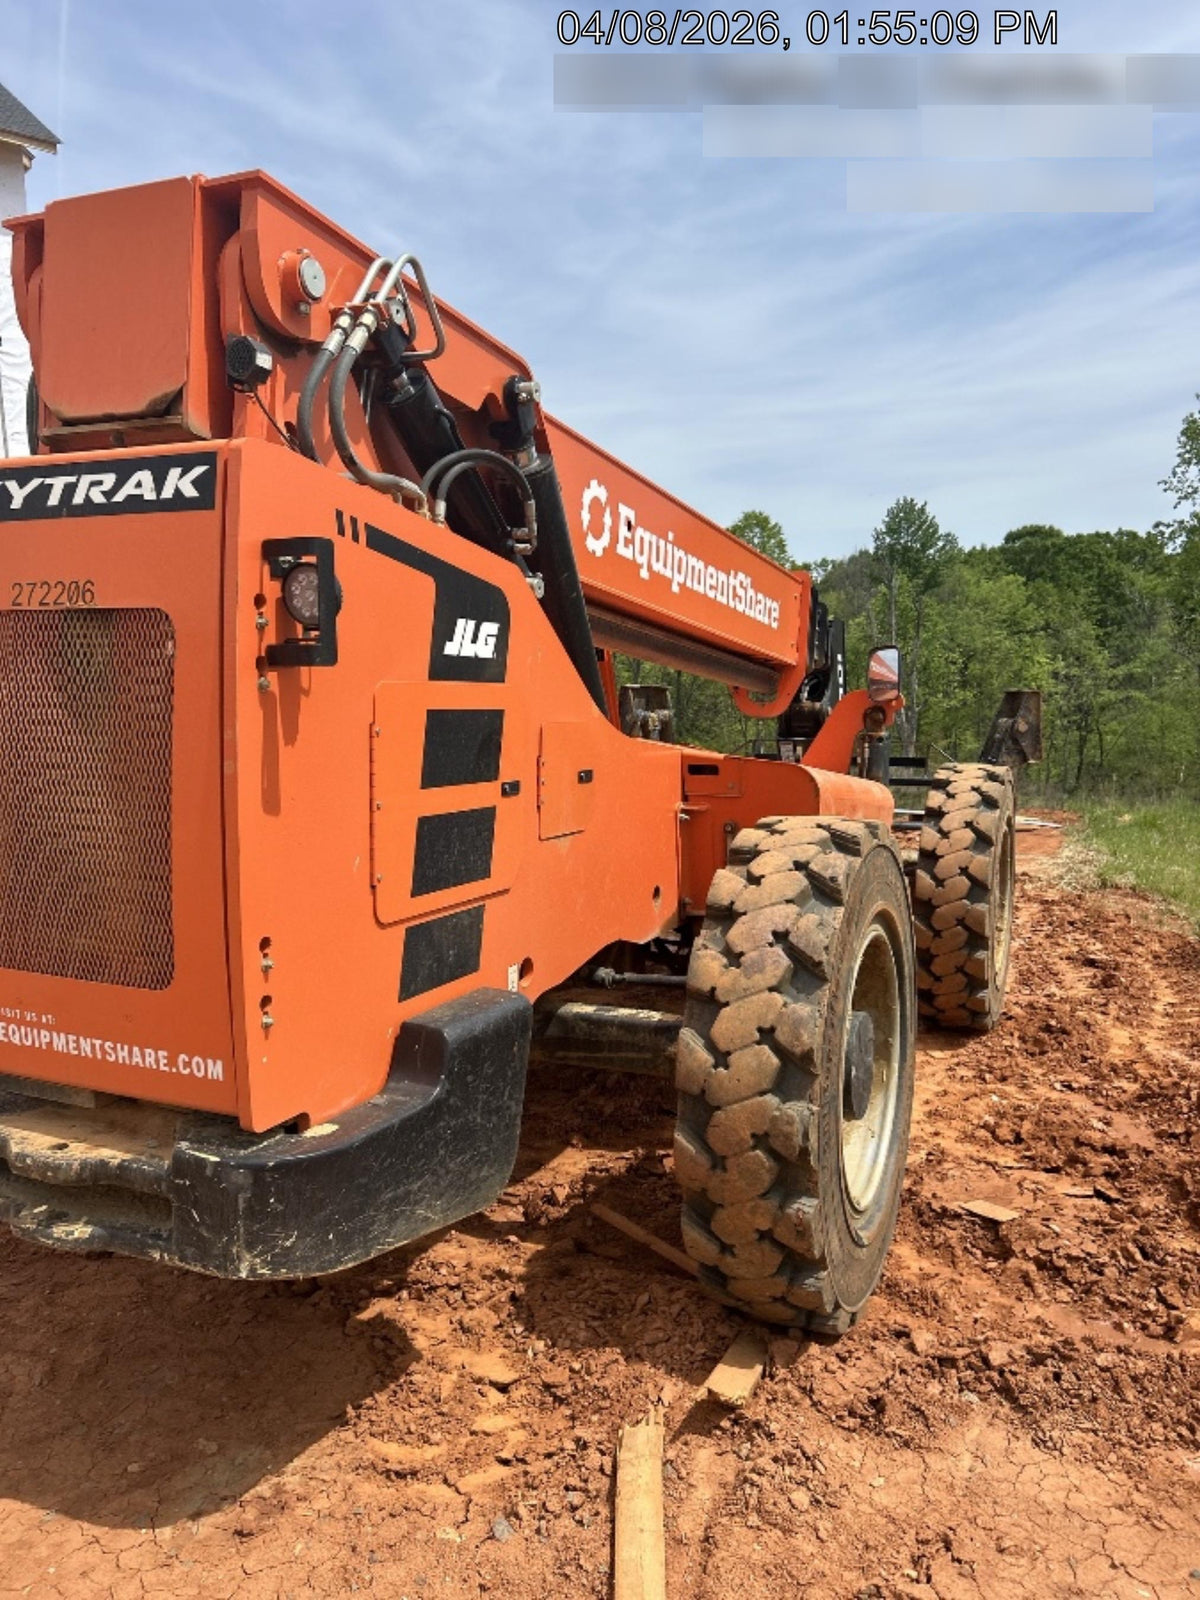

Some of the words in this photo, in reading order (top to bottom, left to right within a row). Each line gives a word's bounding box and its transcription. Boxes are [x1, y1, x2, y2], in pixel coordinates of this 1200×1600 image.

[0, 465, 209, 509] YTRAK
[616, 502, 780, 630] EquipmentShare
[11, 579, 96, 607] 272206
[443, 618, 500, 659] JLG
[24, 1010, 38, 1022] US
[0, 1021, 224, 1082] EQUIPMENTSHARE.COM
